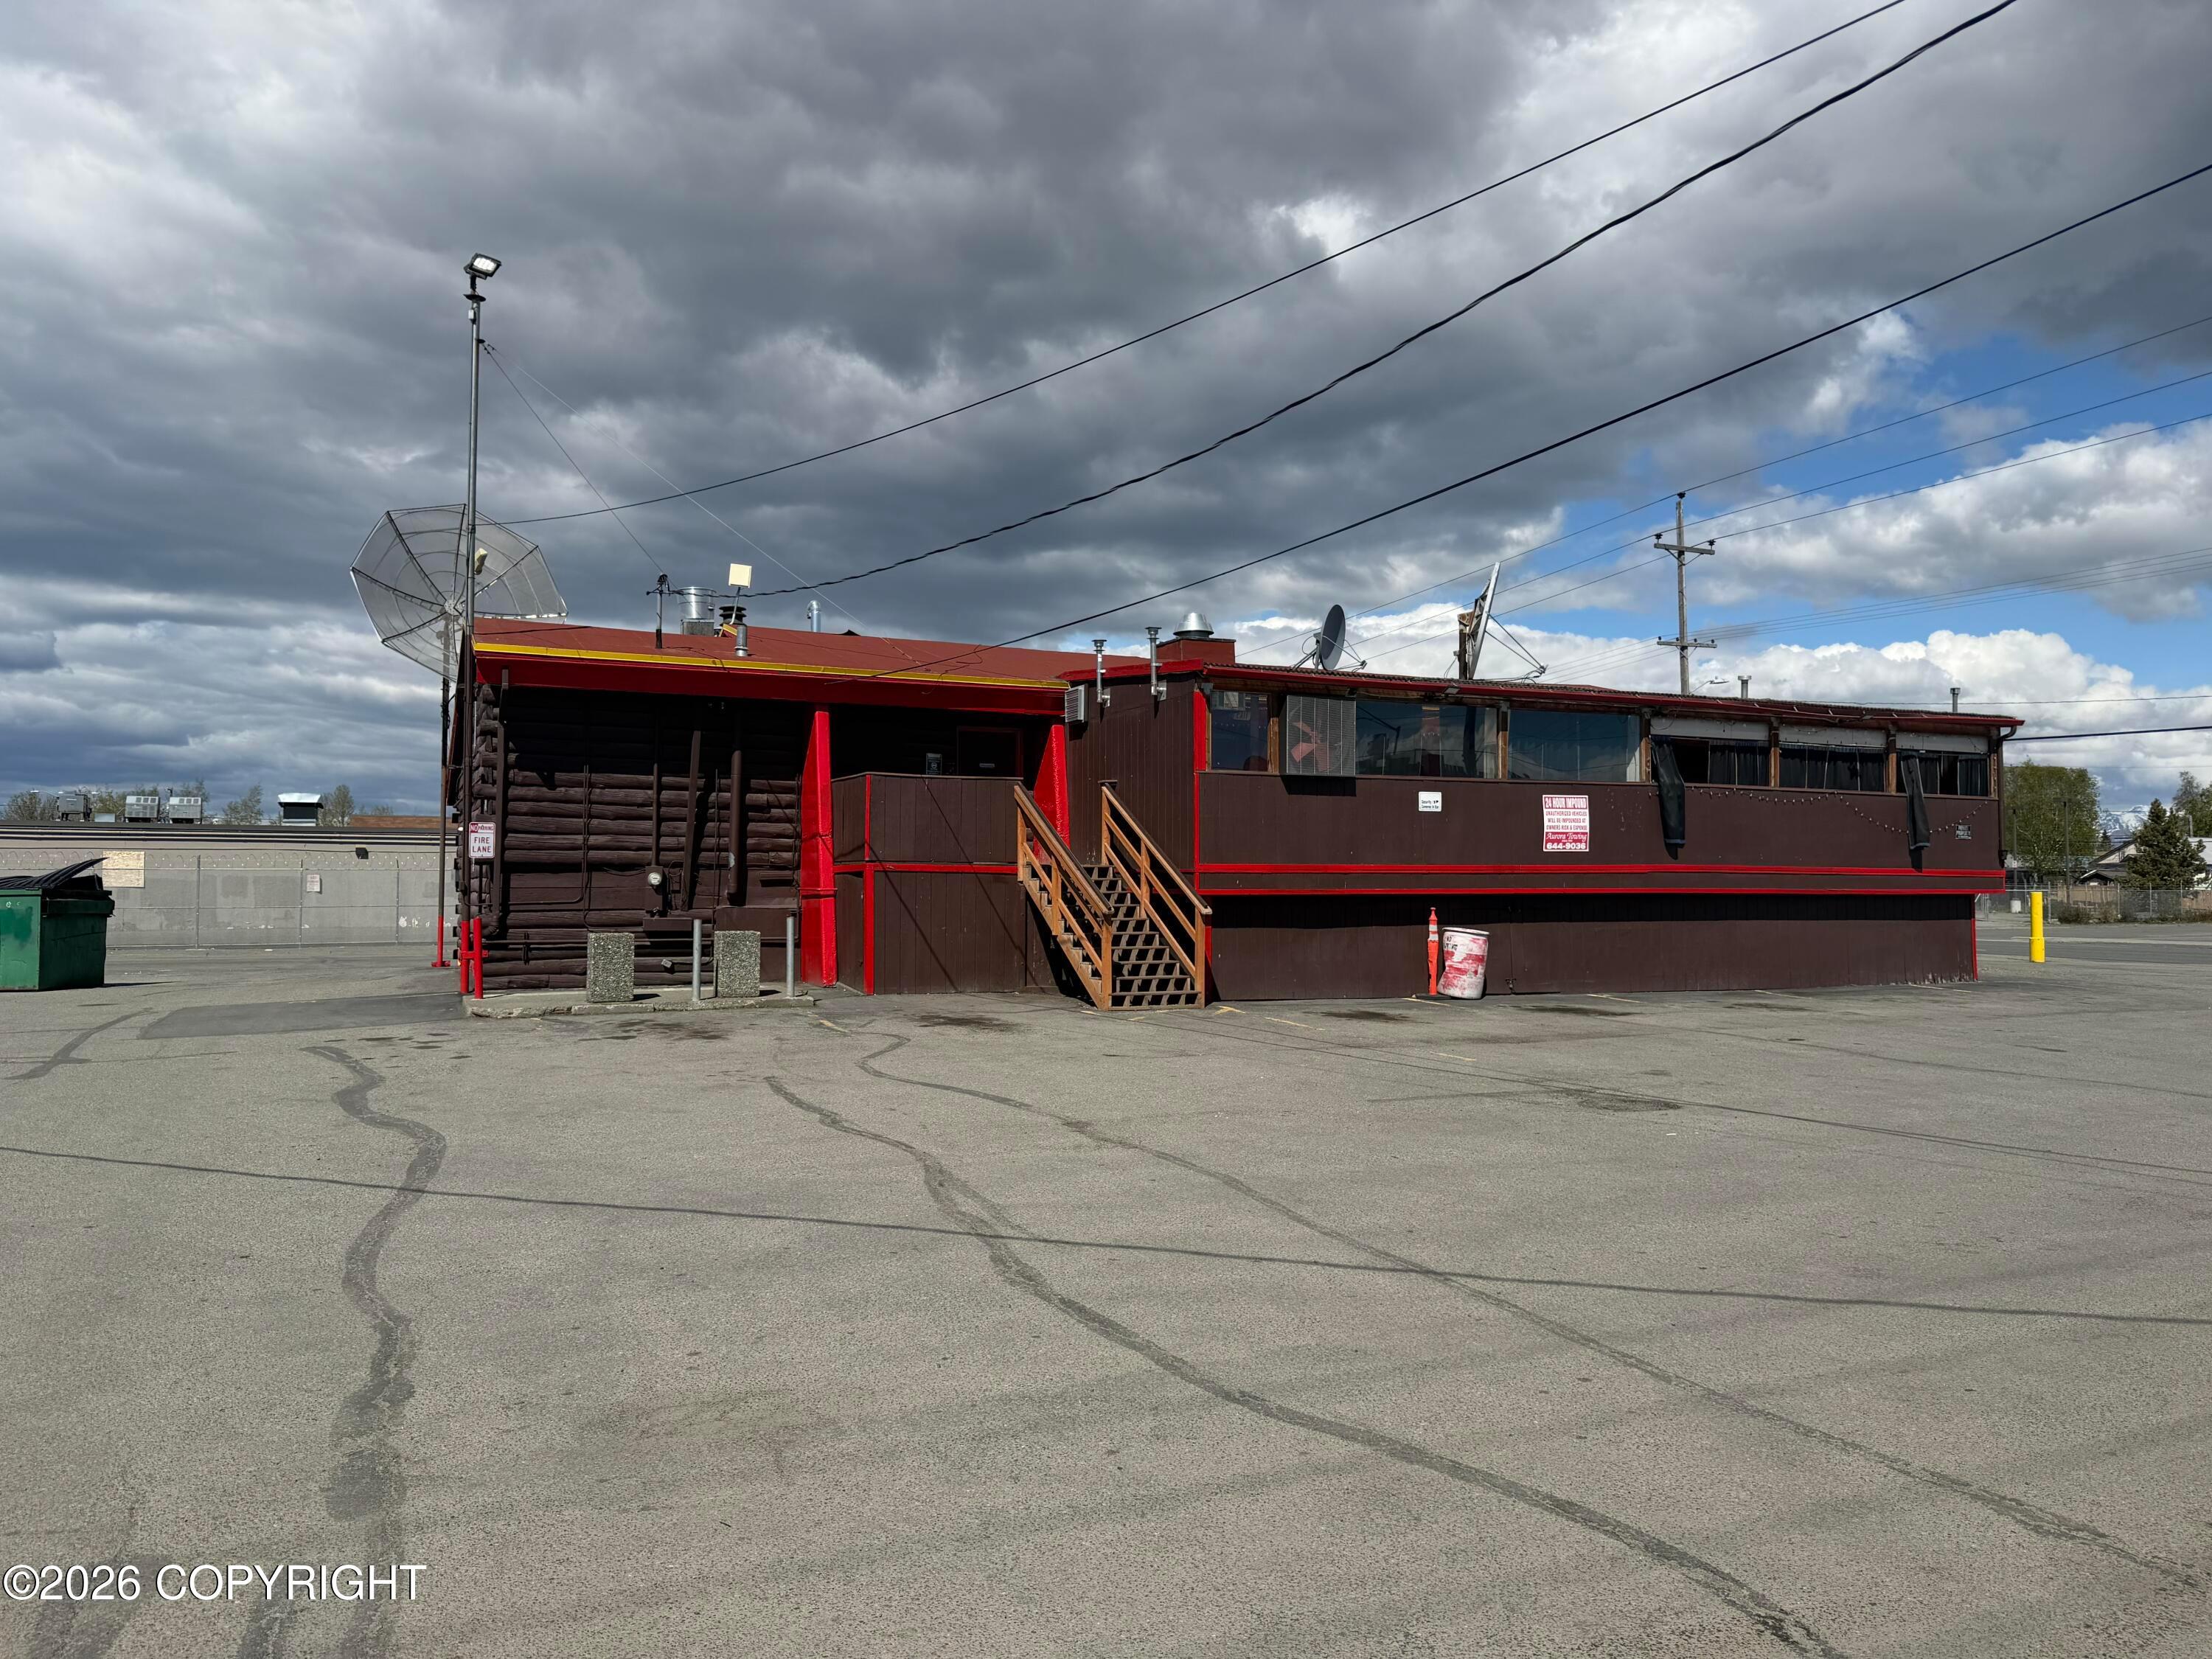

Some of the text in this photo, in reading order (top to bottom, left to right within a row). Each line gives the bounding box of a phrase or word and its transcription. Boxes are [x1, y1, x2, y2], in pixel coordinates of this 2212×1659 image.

[1545, 797, 1587, 809] 24 HOUR IMPOUND
[470, 824, 478, 832] NO
[1567, 832, 1587, 842] Towing
